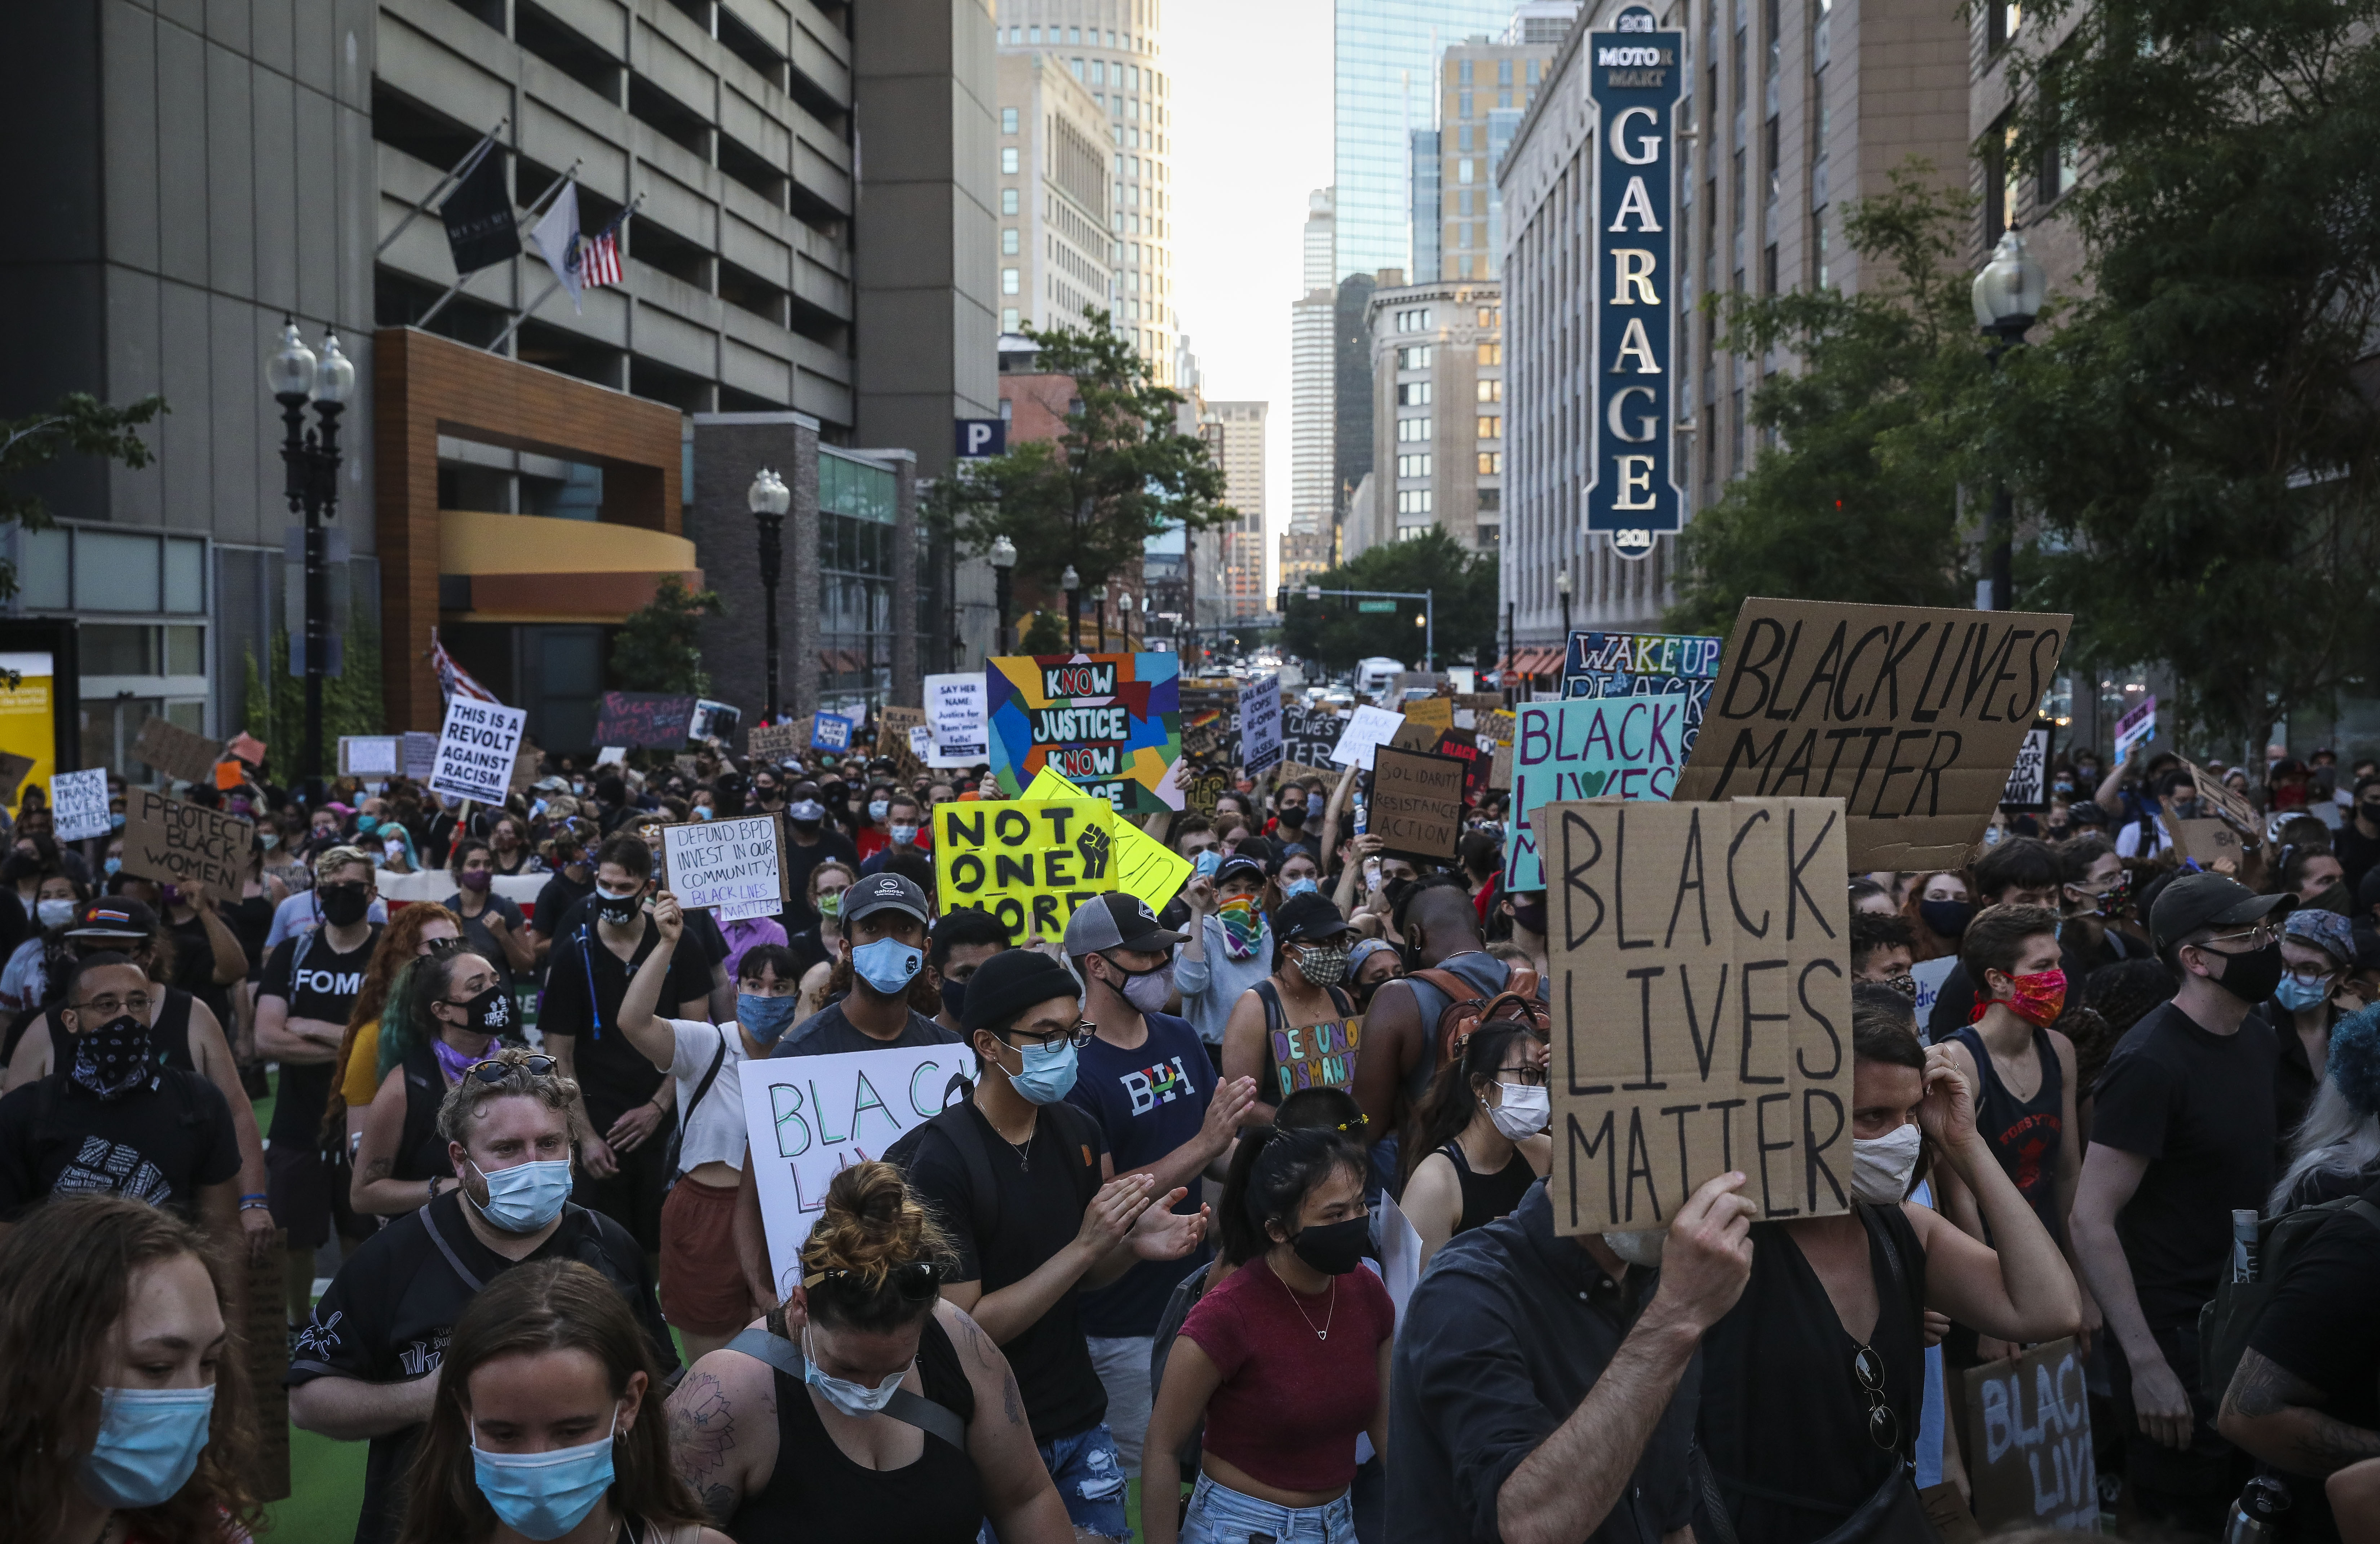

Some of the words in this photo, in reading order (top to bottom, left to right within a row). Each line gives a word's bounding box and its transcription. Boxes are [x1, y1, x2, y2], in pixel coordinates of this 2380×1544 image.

[1619, 14, 1653, 33] 201
[1598, 47, 1675, 66] MOTOR
[1607, 107, 1662, 512] GARAGE
[968, 422, 992, 454] P
[1616, 527, 1650, 548] 201
[1047, 664, 1114, 698] KNOW
[1719, 617, 1932, 721] BLACK
[1911, 621, 2060, 722] LIVES
[941, 684, 957, 694] SAY
[960, 684, 976, 693] HER
[454, 704, 486, 724] THIS
[490, 713, 505, 728] IS
[508, 717, 518, 732] A
[1034, 707, 1127, 742] JUSTICE
[1289, 717, 1334, 736] LIVES
[1360, 713, 1390, 728] BLACK
[448, 722, 515, 752] REVOLT
[1343, 740, 1375, 755] MATTE
[1520, 703, 1676, 766] BLACK
[442, 746, 510, 771] AGAINST
[1048, 746, 1115, 777] KNOW
[1442, 741, 1478, 762] BLACK
[55, 773, 103, 787] BLACK
[443, 762, 501, 787] RACISM
[1380, 762, 1460, 792] SOLIDARITY
[1708, 726, 1962, 820] MATTER
[56, 785, 104, 800] TRANS
[56, 797, 105, 814] LIVES
[1375, 792, 1457, 819] RESISTANCE
[54, 811, 111, 830] MATTER
[143, 793, 250, 845] PROTECT
[677, 825, 734, 846] DEFUND
[739, 820, 771, 840] BPD
[947, 807, 1074, 846] NOT
[1379, 817, 1449, 845] ACTION
[167, 824, 236, 863] BLACK
[677, 845, 724, 870] INVEST
[733, 844, 746, 859] IN
[751, 840, 774, 857] OUR
[144, 847, 236, 890] WOMEN
[682, 855, 777, 889] COMMUNITY!
[951, 851, 1076, 893] ONE
[1562, 807, 1837, 952] BLACK
[692, 886, 737, 906] BLACK
[740, 883, 768, 899] LIVES
[725, 898, 780, 920] MATTER!
[951, 892, 1122, 937] ORE
[295, 969, 366, 995] FOM
[1274, 1019, 1358, 1062] DEFUND
[1566, 958, 1842, 1096] LIVES
[1280, 1050, 1356, 1095] DISMANT
[1567, 1088, 1850, 1228] MATTER
